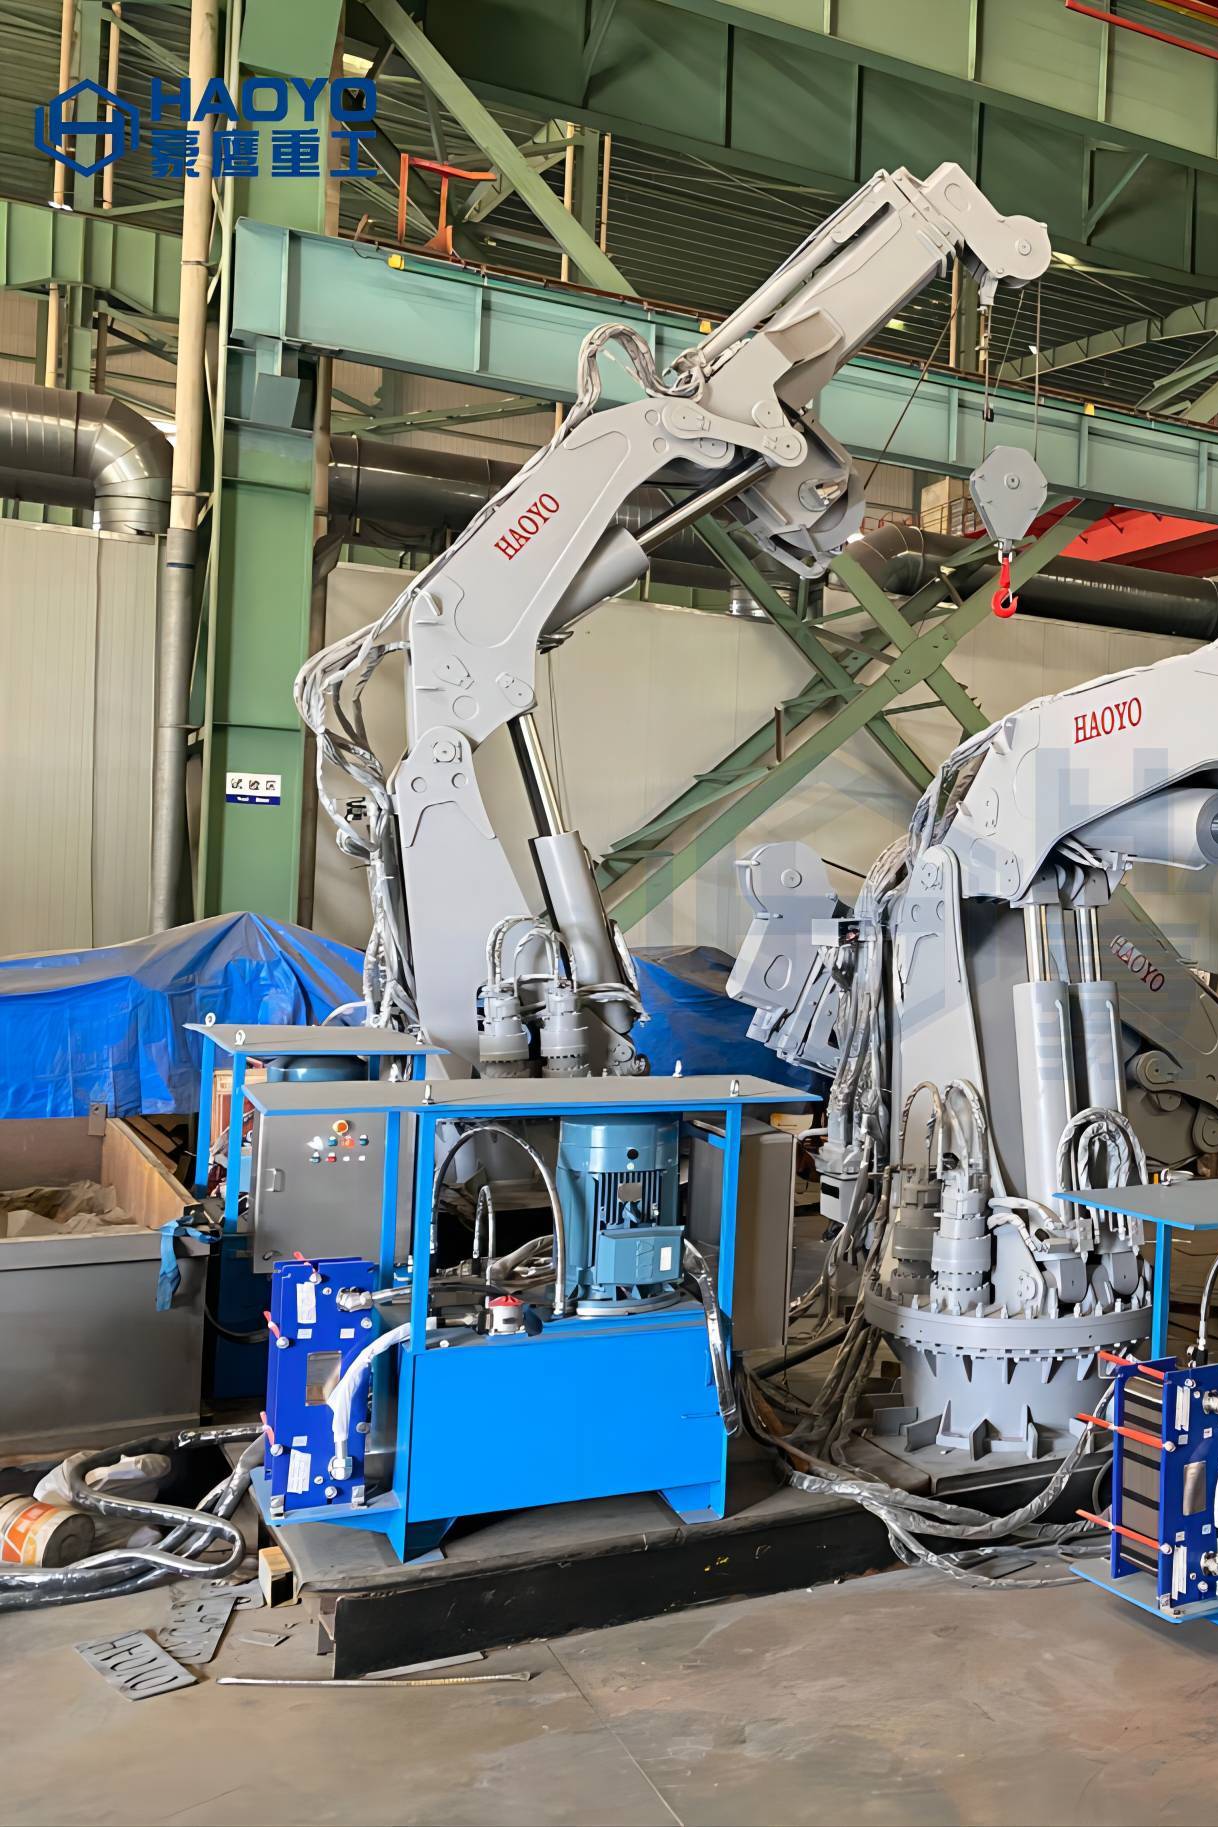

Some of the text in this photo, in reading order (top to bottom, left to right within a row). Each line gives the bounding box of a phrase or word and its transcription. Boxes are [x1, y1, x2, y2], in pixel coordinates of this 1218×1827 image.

[494, 494, 560, 560] HAOYO
[1074, 697, 1142, 744] HAOYO
[1110, 935, 1165, 992] HAOYO
